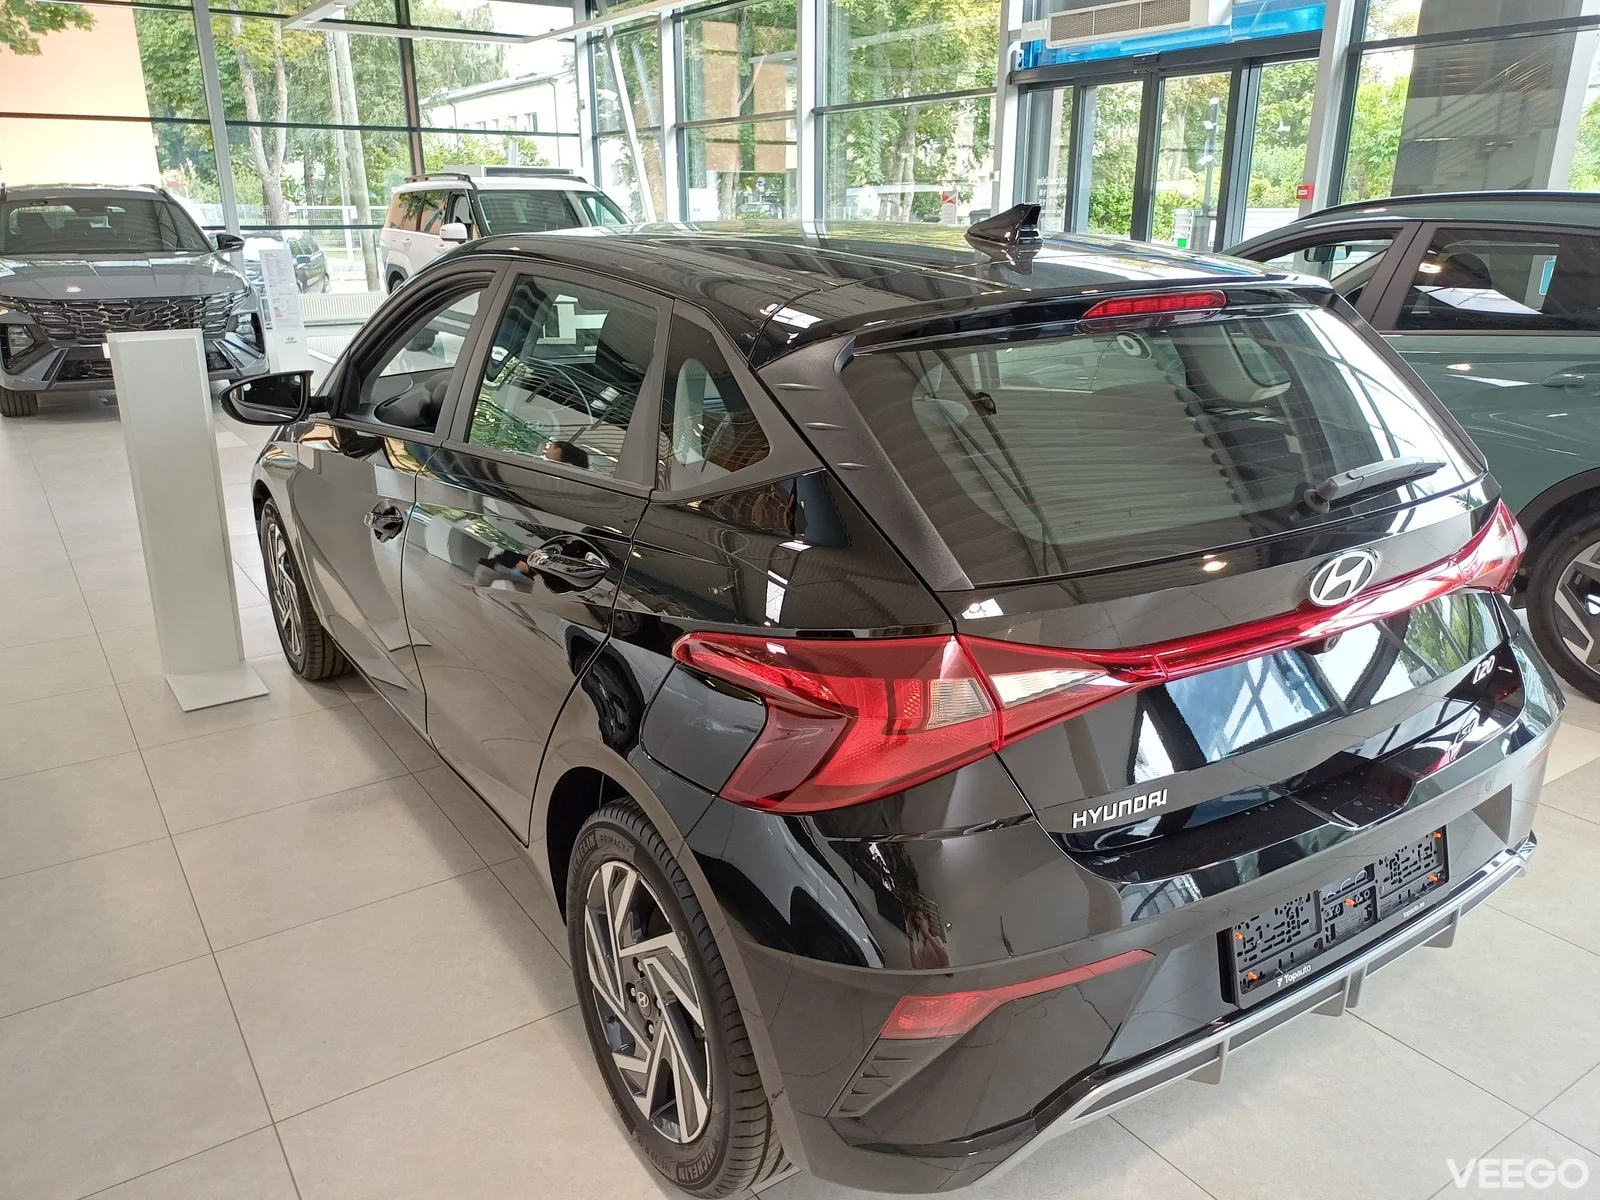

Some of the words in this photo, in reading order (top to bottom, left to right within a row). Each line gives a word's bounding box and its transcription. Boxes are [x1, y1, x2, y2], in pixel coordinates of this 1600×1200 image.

[1072, 788, 1168, 829] HYUNDAI
[1284, 964, 1312, 984] Topauto
[677, 1140, 717, 1181] MICHELIN
